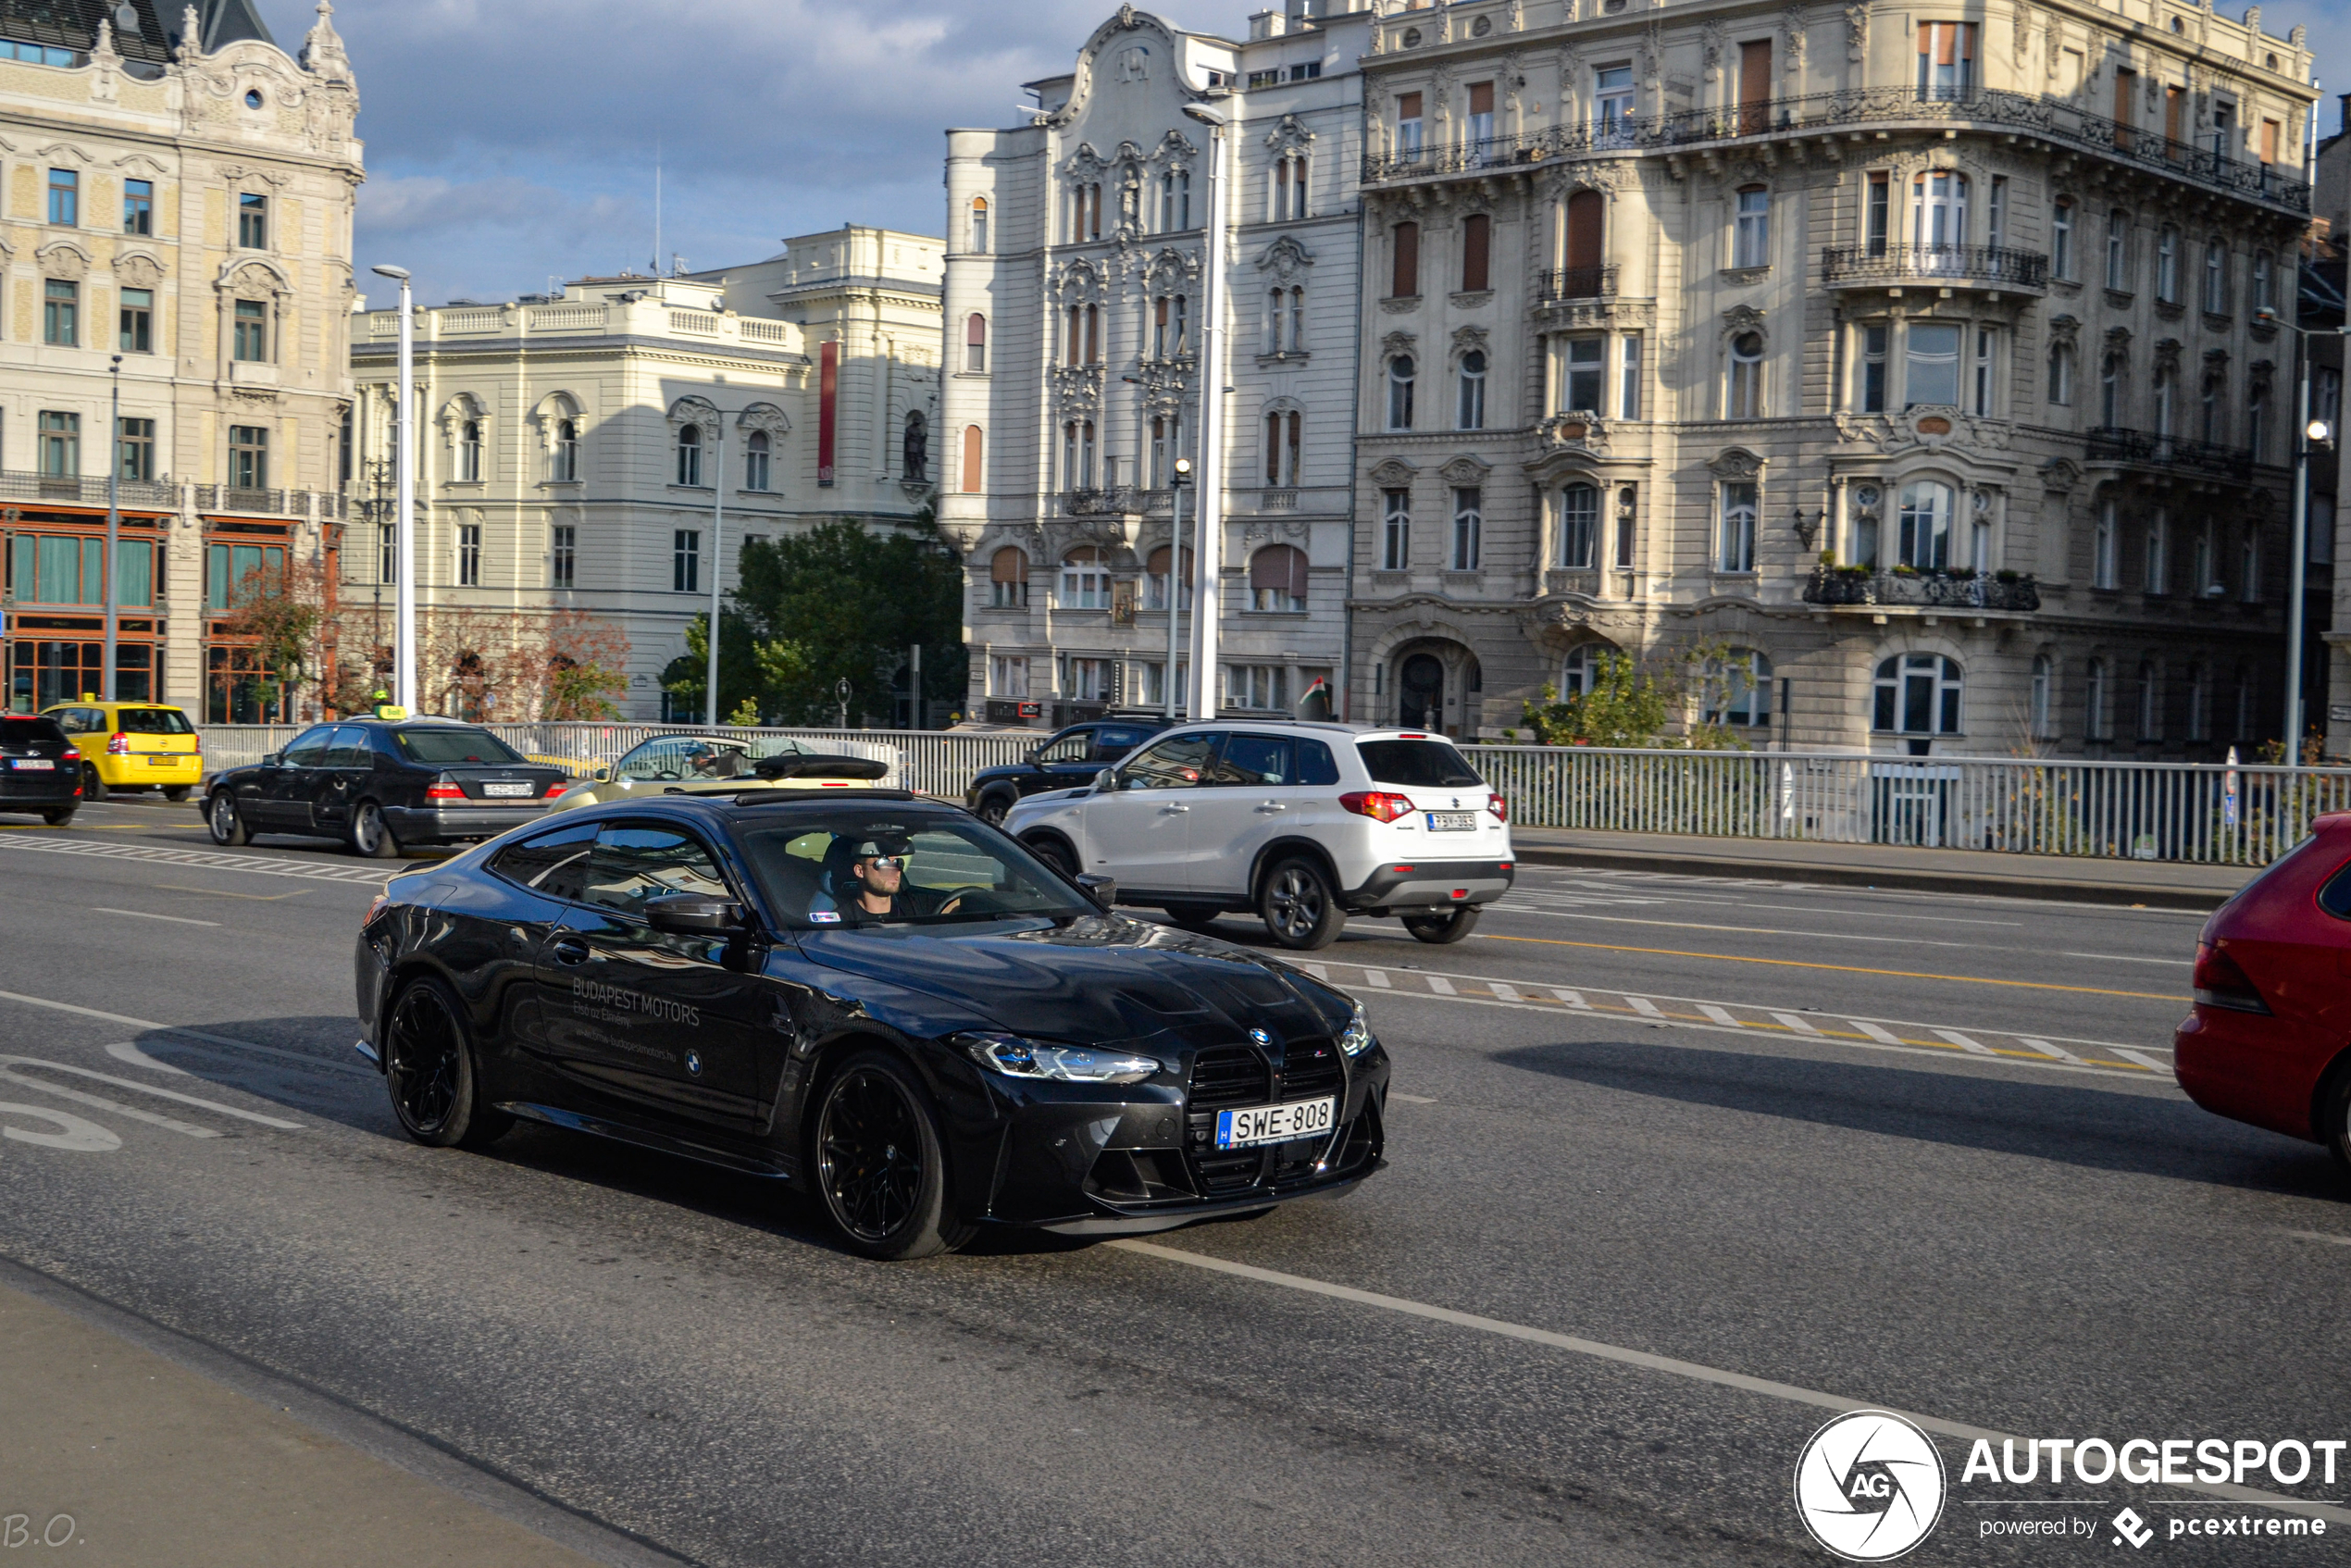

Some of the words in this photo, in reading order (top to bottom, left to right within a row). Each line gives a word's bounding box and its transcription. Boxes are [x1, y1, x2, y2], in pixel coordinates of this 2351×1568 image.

[573, 977, 639, 1011] BUDAPEST
[641, 995, 700, 1027] MOTORS
[591, 1009, 600, 1019] az
[1236, 1101, 1329, 1139] SWE-808
[1220, 1130, 1227, 1140] H
